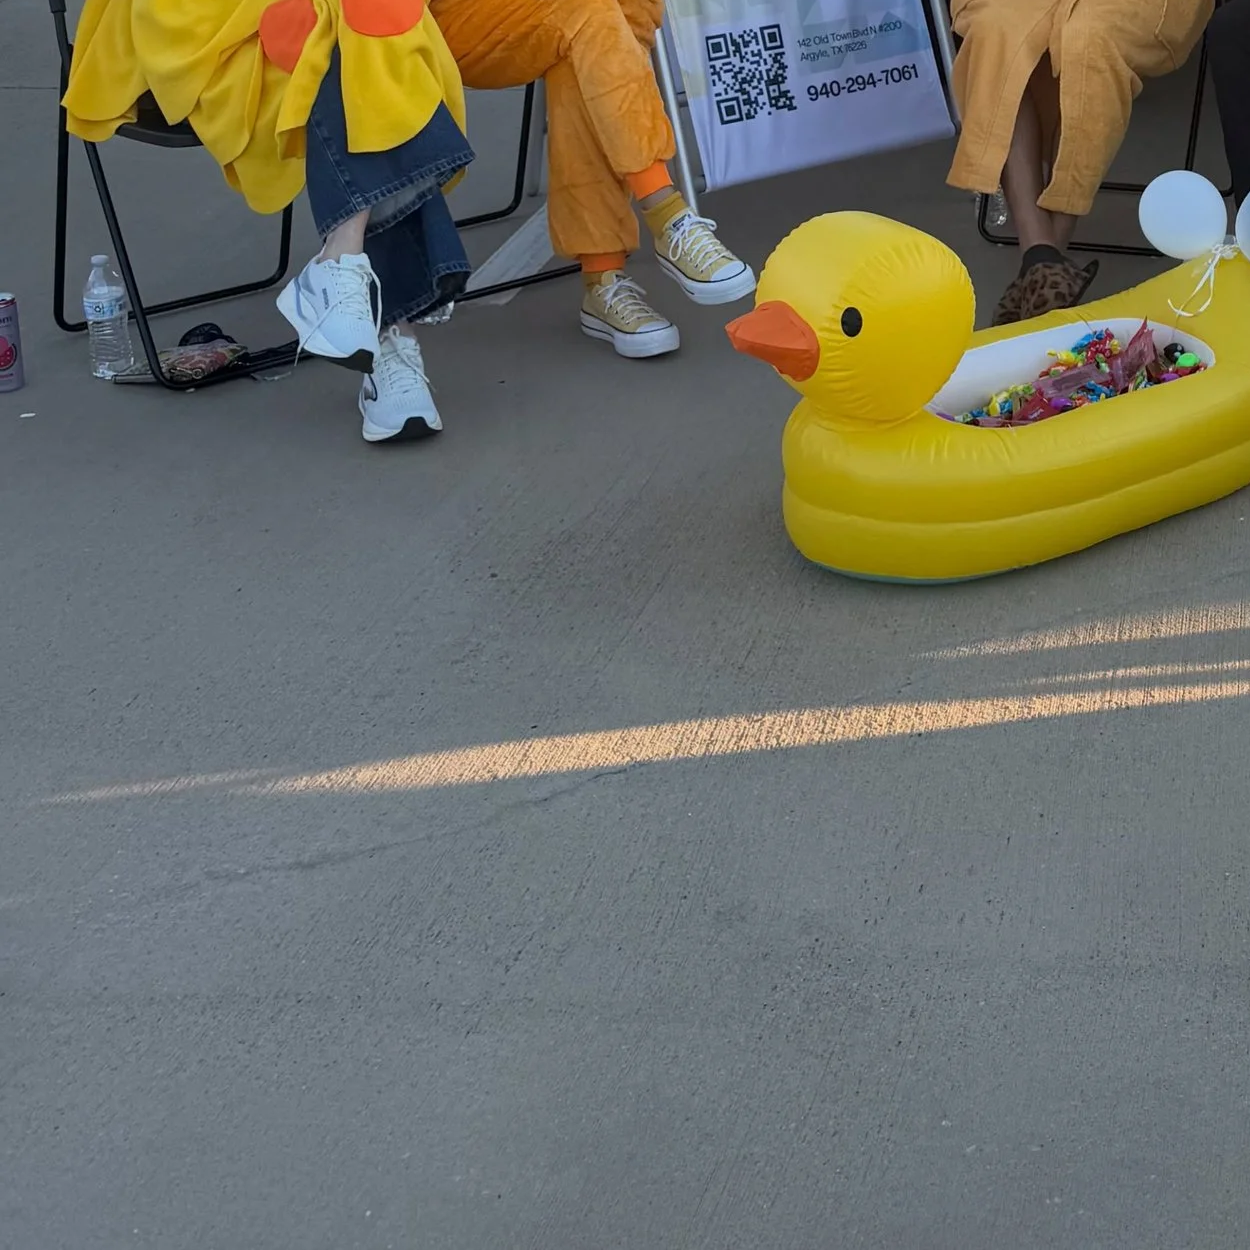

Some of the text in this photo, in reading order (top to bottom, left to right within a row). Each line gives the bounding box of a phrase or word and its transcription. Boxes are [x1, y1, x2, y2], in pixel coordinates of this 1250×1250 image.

[797, 37, 812, 48] 142
[813, 34, 829, 46] Old
[830, 29, 852, 42] Town
[869, 25, 878, 34] N
[879, 20, 902, 33] #200
[800, 48, 830, 62] Argyle,
[831, 44, 844, 56] TX
[807, 63, 919, 102] 940-294-7061
